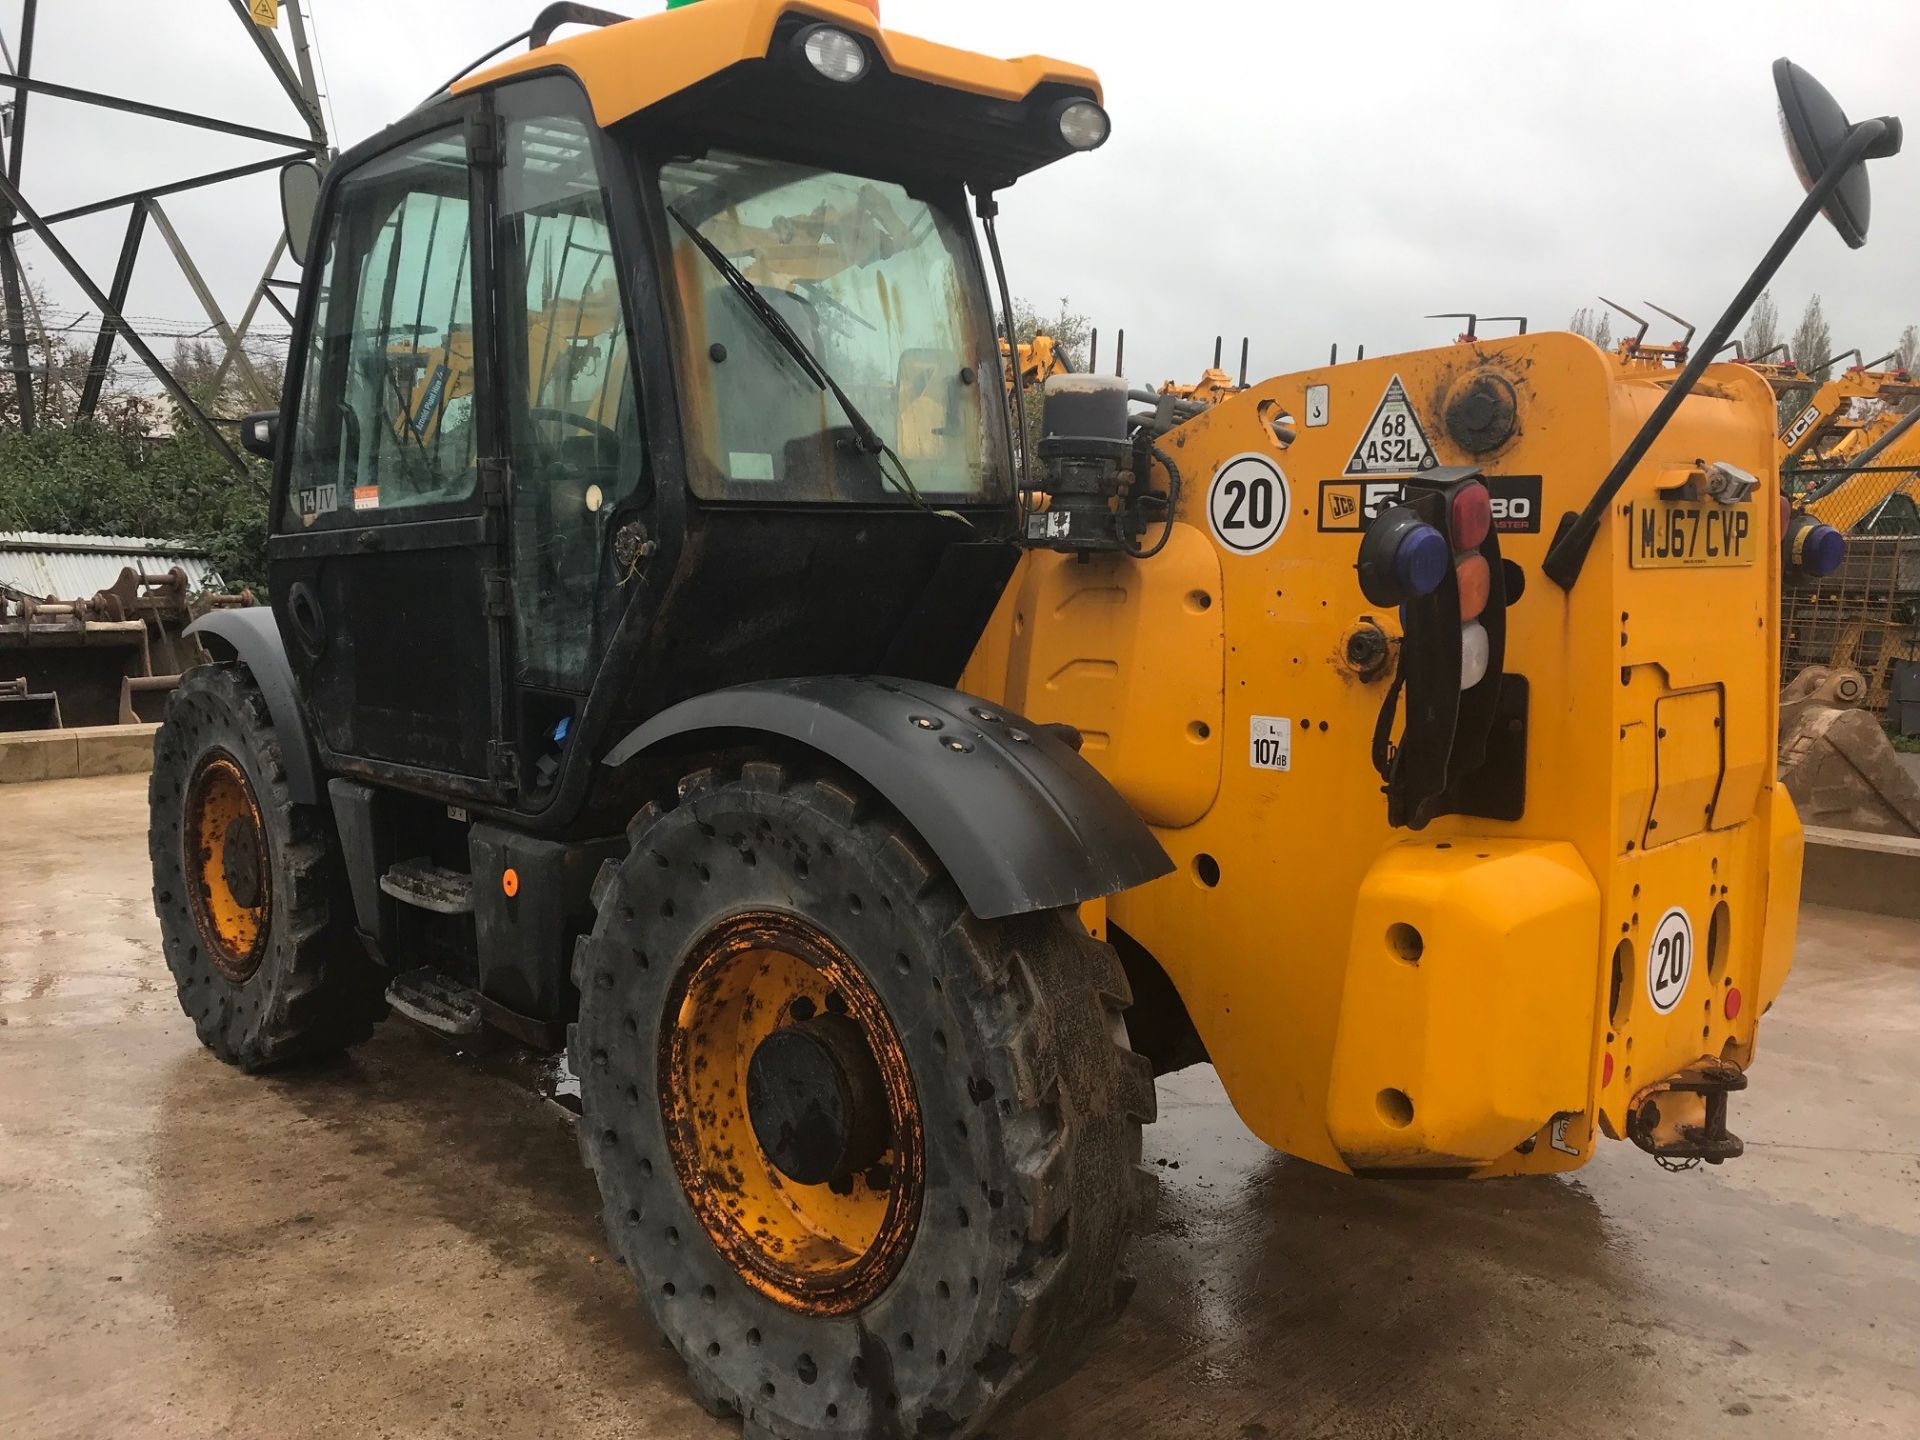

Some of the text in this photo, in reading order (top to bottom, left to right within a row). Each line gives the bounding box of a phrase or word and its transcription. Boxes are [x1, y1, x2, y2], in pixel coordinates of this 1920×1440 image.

[424, 391, 437, 410] Plant
[1381, 413, 1406, 438] 68
[1787, 406, 1820, 447] JCB
[1366, 439, 1420, 463] AS2L
[1222, 477, 1273, 530] 20
[1332, 496, 1355, 517] JCB
[1641, 508, 1749, 559] MJ67 CVP
[1655, 931, 1685, 992] 20
